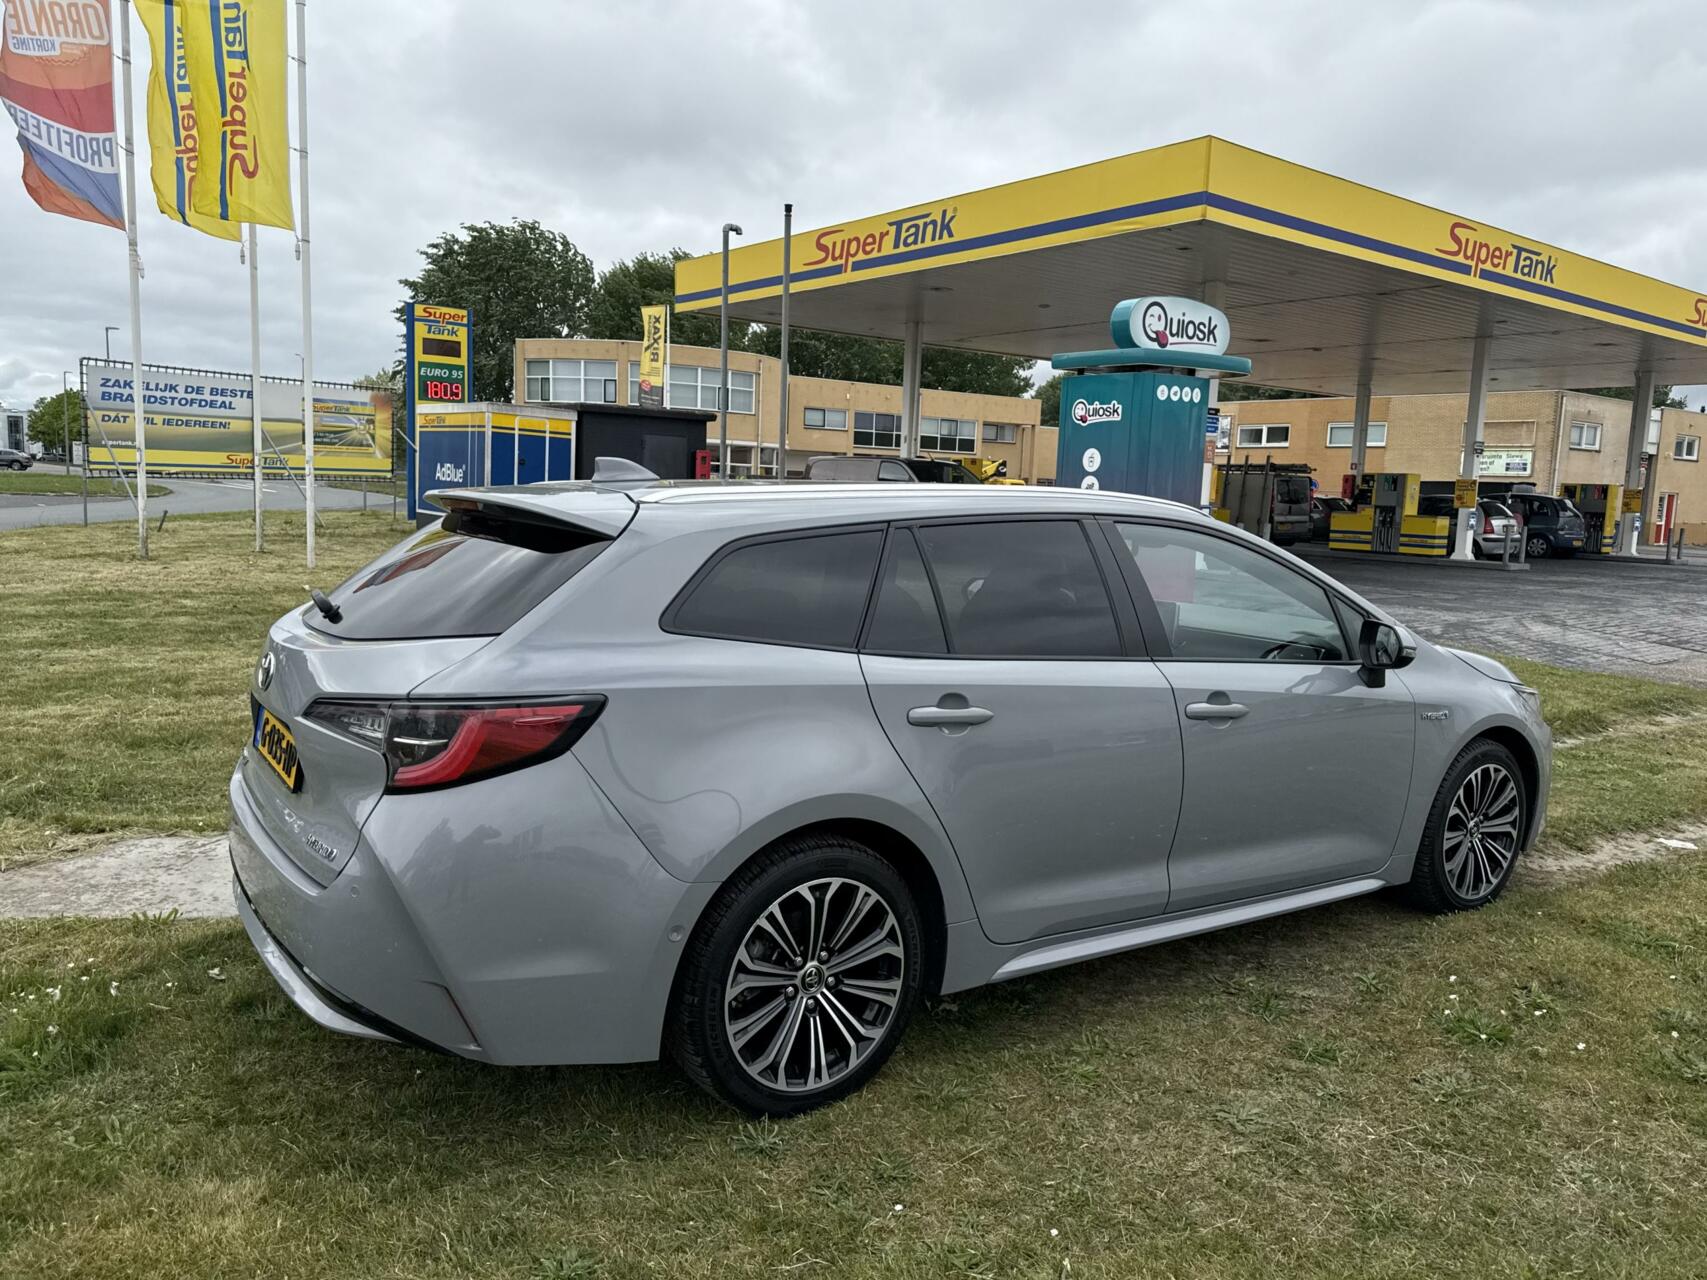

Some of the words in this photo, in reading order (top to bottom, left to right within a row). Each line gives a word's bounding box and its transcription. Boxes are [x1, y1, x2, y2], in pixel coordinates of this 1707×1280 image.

[415, 306, 467, 325] Super
[1142, 300, 1218, 348] Quiosk
[423, 323, 460, 337] Tank
[420, 367, 449, 377] EURO
[451, 369, 464, 379] 95
[100, 377, 179, 394] ZAKLIJK
[184, 384, 205, 396] DE
[101, 412, 129, 424] DÁT
[162, 417, 231, 430] IEDEREEN!
[1073, 401, 1121, 424] Quiosk
